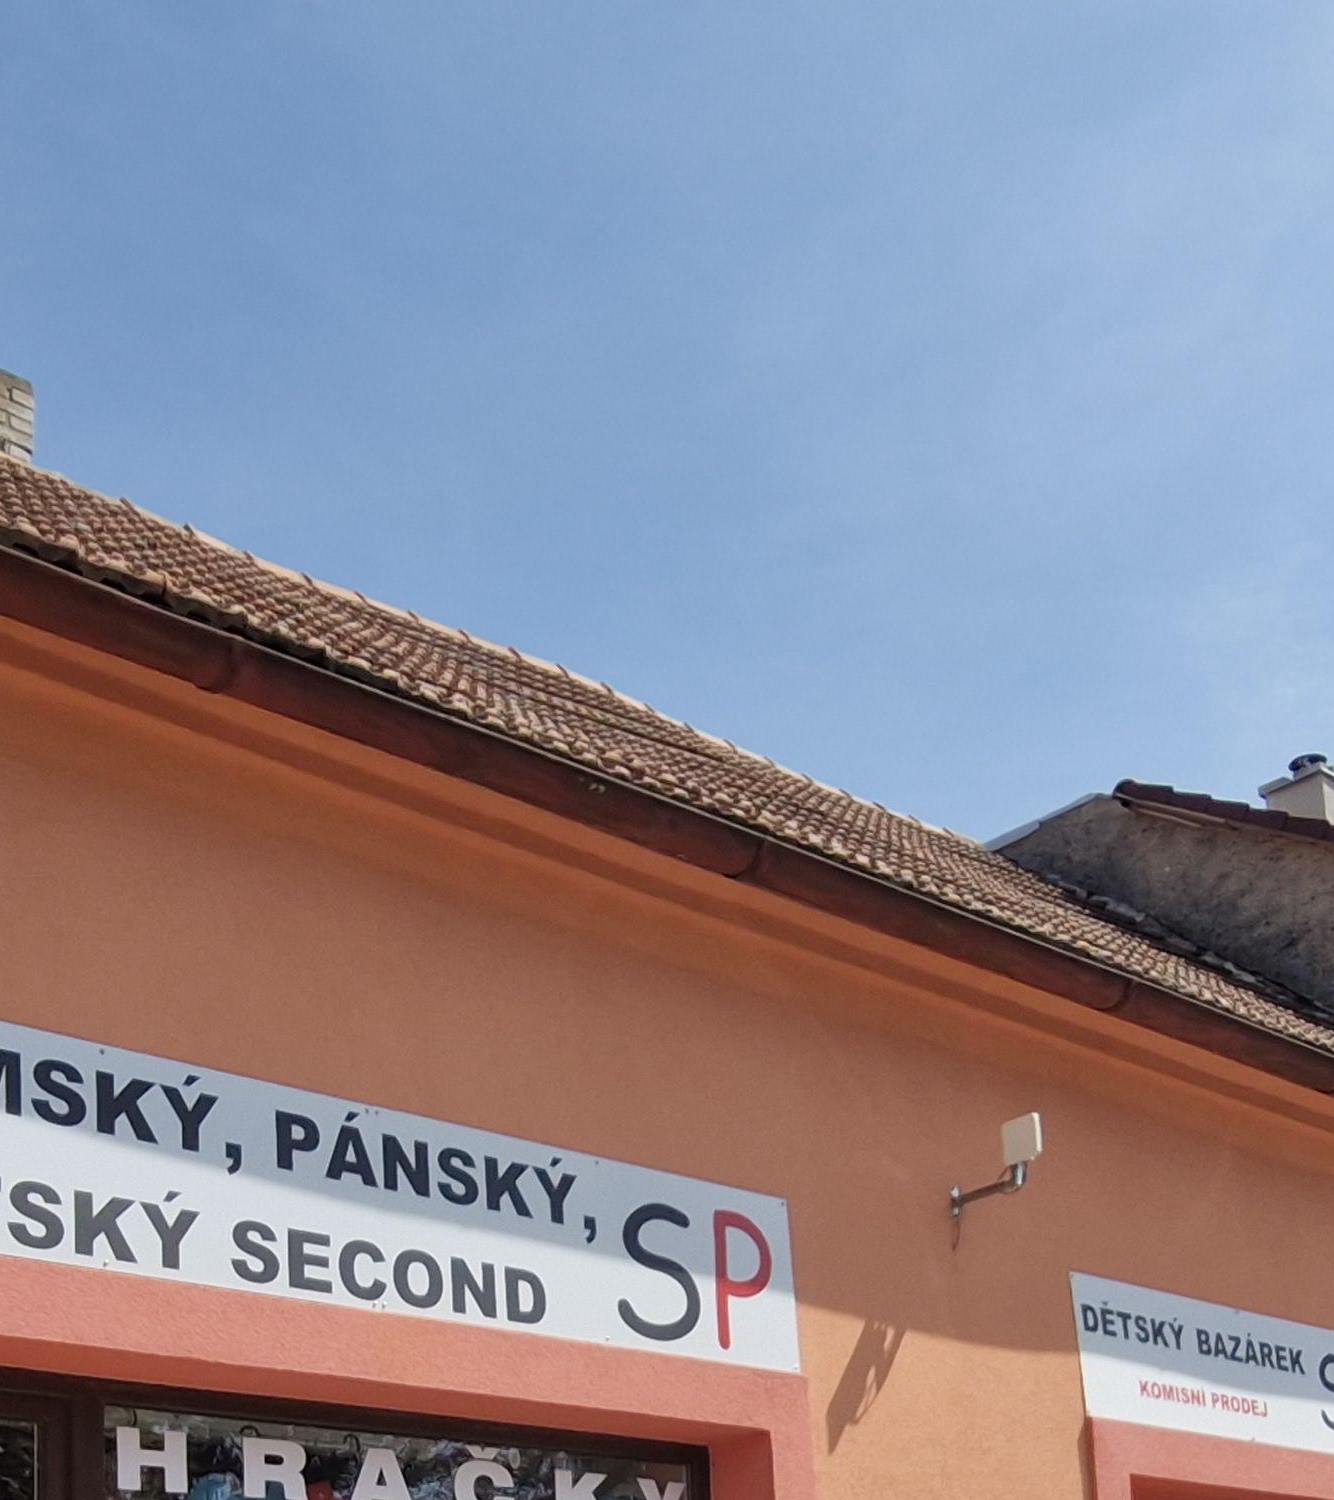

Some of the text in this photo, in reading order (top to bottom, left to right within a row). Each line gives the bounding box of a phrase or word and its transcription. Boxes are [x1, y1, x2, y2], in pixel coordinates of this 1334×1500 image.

[275, 1110, 598, 1244] PÁNSKÝ,
[230, 1220, 547, 1327] SECOND
[617, 1203, 773, 1350] SP
[1080, 1301, 1306, 1376] DĚTSKÝ BAZÁREK
[1139, 1380, 1269, 1418] KOMISNÍ PRODEJ
